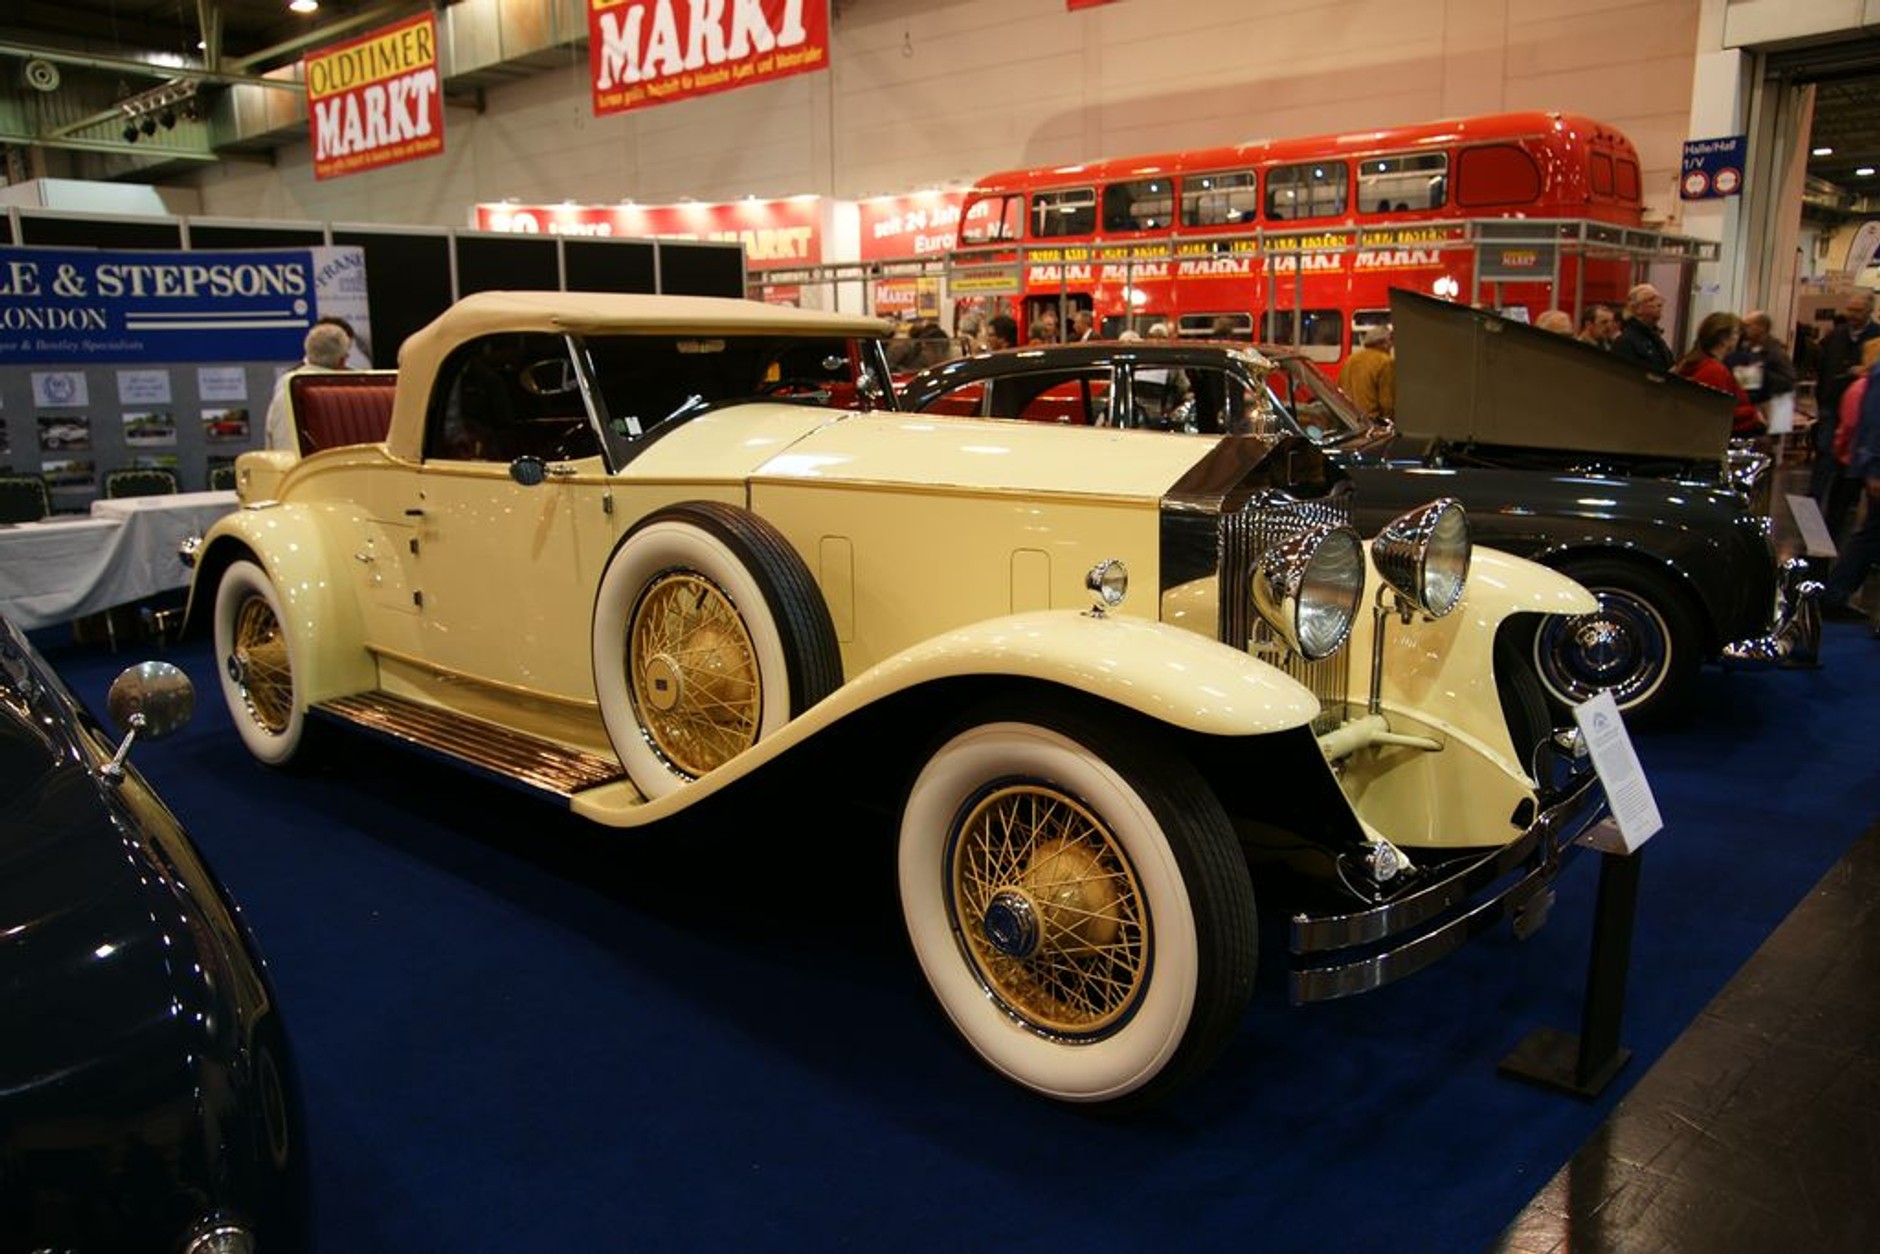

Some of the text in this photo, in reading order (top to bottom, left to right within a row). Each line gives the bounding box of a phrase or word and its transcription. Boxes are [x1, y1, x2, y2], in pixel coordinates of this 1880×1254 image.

[310, 26, 431, 95] OLDTIMER
[315, 68, 436, 161] MARKT
[930, 200, 988, 227] Jahen
[0, 262, 40, 296] E
[53, 263, 87, 296] &
[96, 264, 307, 297] STEPSONS
